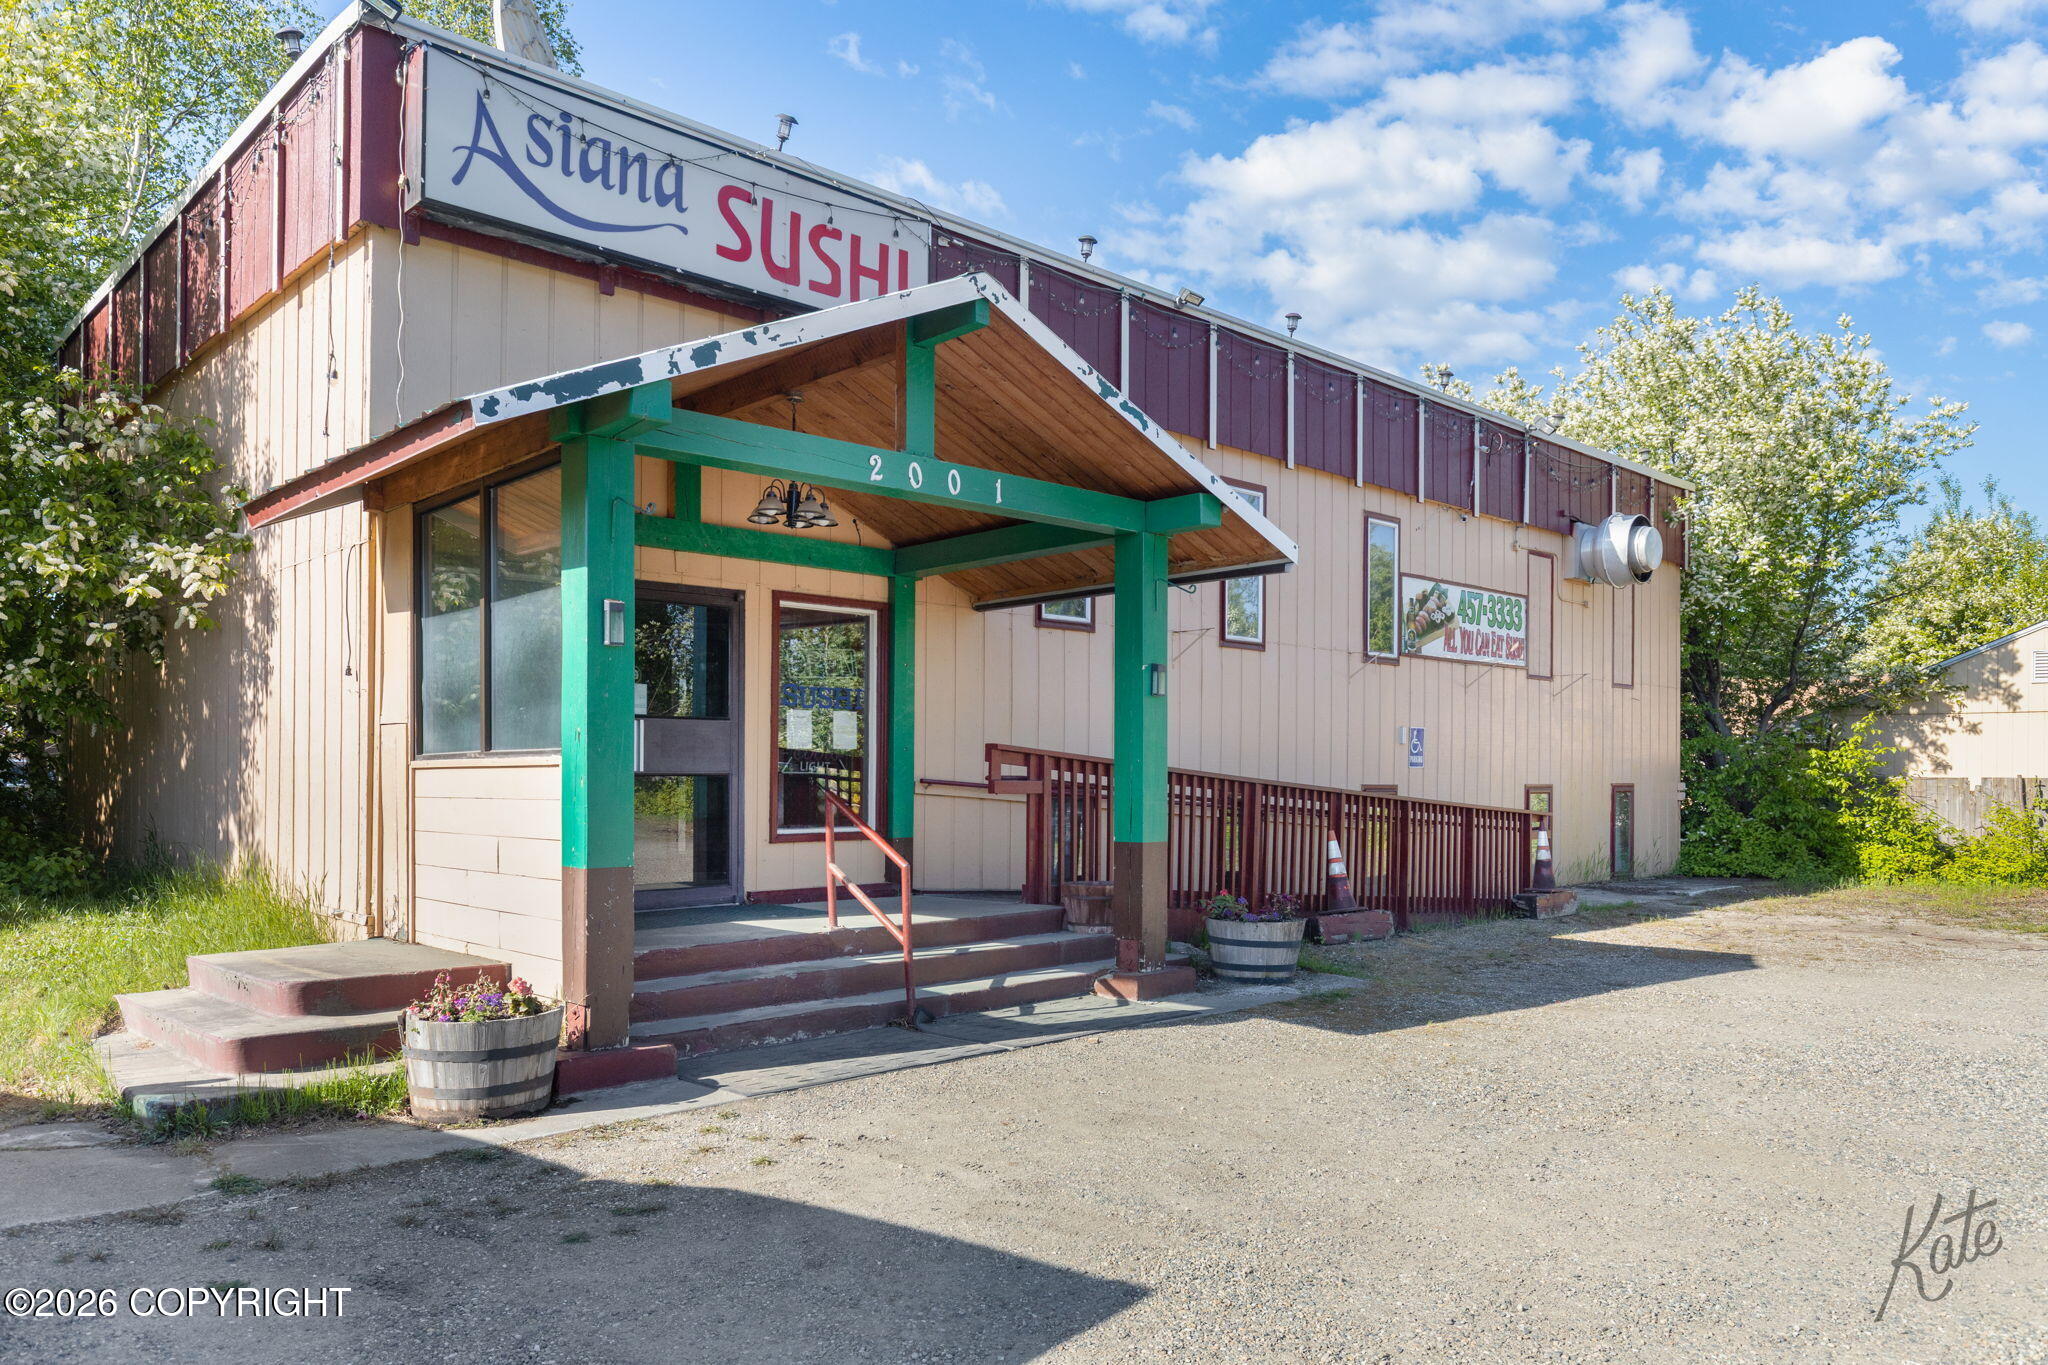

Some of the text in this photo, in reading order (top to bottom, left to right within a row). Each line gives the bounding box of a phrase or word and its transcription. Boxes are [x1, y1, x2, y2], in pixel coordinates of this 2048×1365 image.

[452, 89, 689, 235] Asiana
[716, 185, 909, 303] SUSHI
[869, 454, 1002, 504] 2001
[1457, 589, 1523, 632] 457-3333
[1444, 624, 1457, 653] ALL
[1459, 626, 1474, 655] YOU
[1475, 628, 1491, 657] CAN
[1491, 631, 1504, 659] EAT
[781, 683, 865, 709] SUSHI
